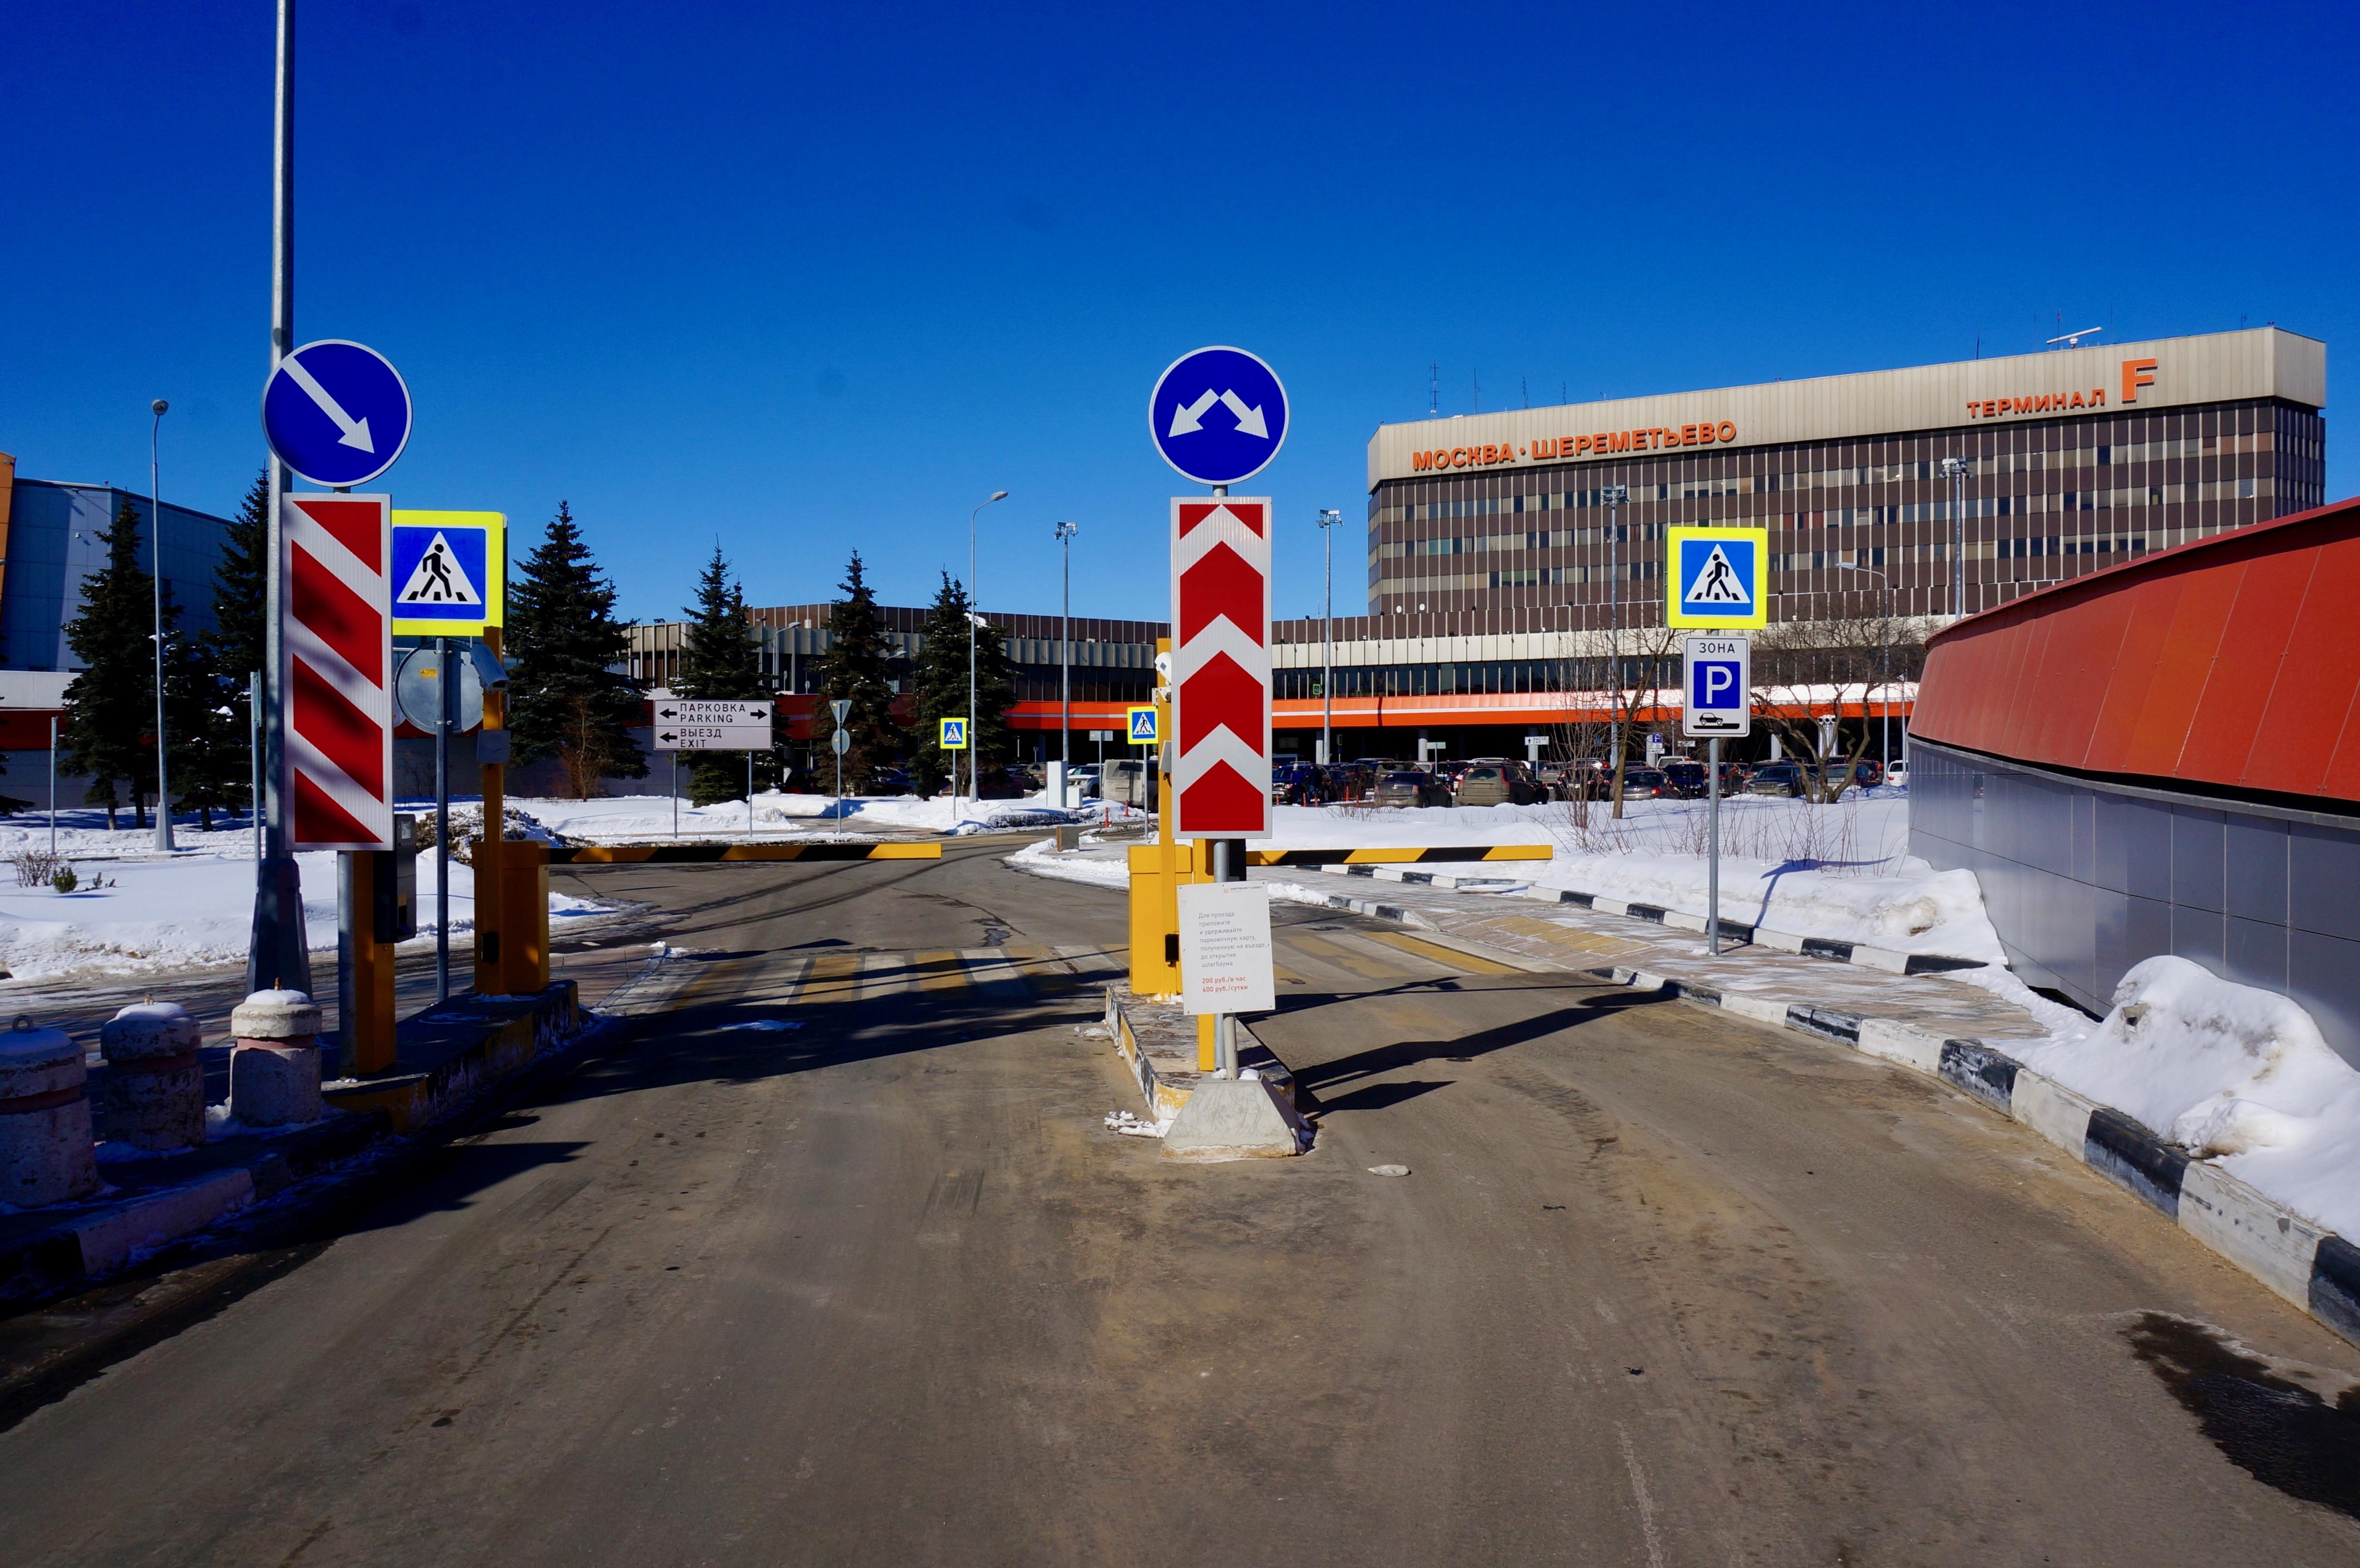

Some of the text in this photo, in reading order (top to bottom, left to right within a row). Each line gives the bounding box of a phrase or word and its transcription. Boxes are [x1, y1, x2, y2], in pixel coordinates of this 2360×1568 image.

[1967, 358, 2158, 418] ТЕРМИНАЛ F
[1412, 420, 1737, 470] МОСКВА ШЕРЕМЕТЬЕВО
[1699, 643, 1735, 653] ЗОНА
[1706, 666, 1733, 704] P
[680, 703, 746, 712] ПАРКОВКА
[680, 714, 733, 722] PARKING
[680, 729, 722, 738] ВЫЕЗД
[1205, 927, 1242, 936] удерживайте
[1215, 984, 1248, 993] руб./сутки
